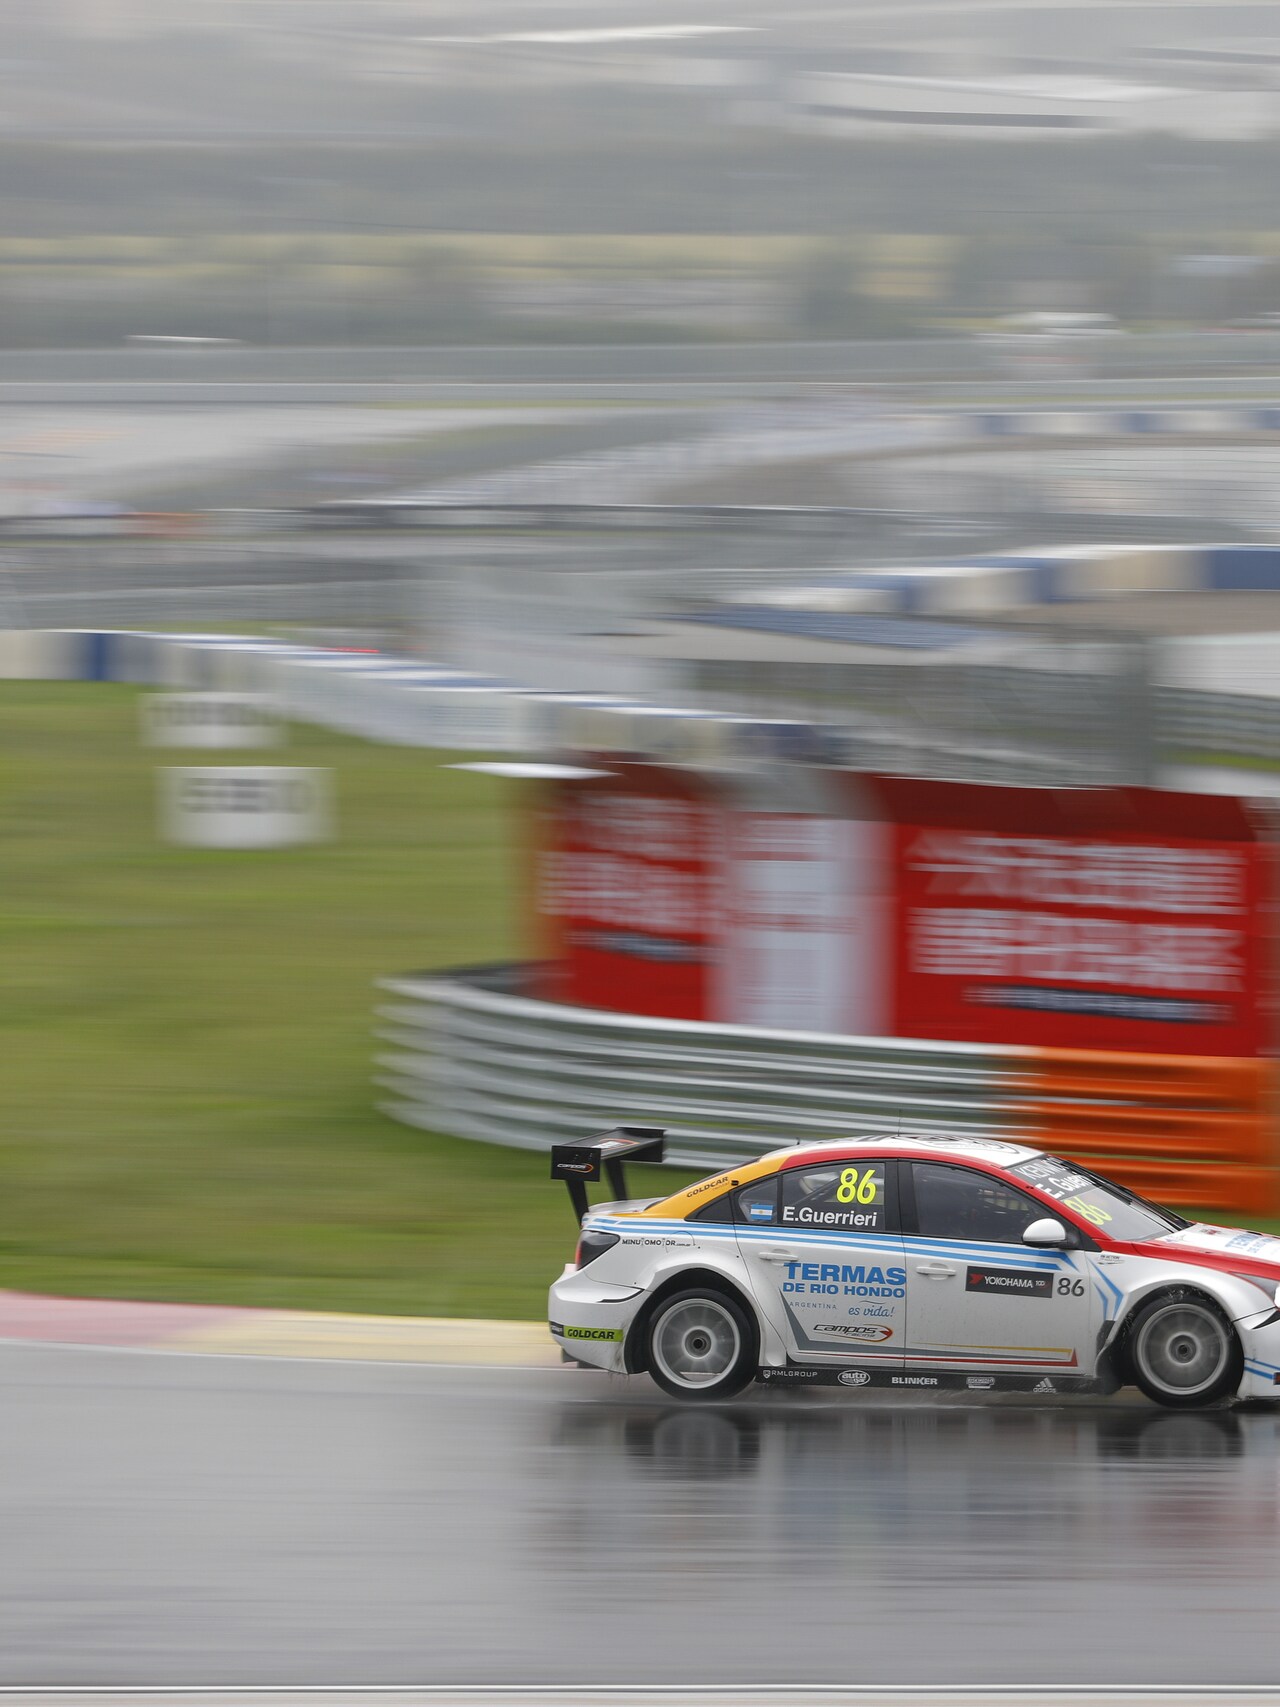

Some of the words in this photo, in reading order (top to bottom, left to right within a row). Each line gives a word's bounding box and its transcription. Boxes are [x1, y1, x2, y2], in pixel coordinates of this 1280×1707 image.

[686, 1176, 729, 1198] GOLDCAR
[836, 1168, 877, 1204] 86
[782, 1206, 878, 1227] E.Guerrieri
[1063, 1196, 1113, 1226] 86
[783, 1262, 907, 1286] TERMAS
[984, 1275, 1033, 1289] YOKOHAMA
[782, 1282, 806, 1293] DE
[810, 1283, 839, 1295] RIO
[843, 1285, 905, 1299] HONDO
[1057, 1277, 1085, 1298] 86
[789, 1301, 838, 1310] ARGENTINA
[848, 1307, 860, 1316] es
[863, 1304, 895, 1318] vida!
[567, 1328, 615, 1340] GOLDCAR
[813, 1324, 878, 1334] campos
[891, 1376, 938, 1385] BLINKER
